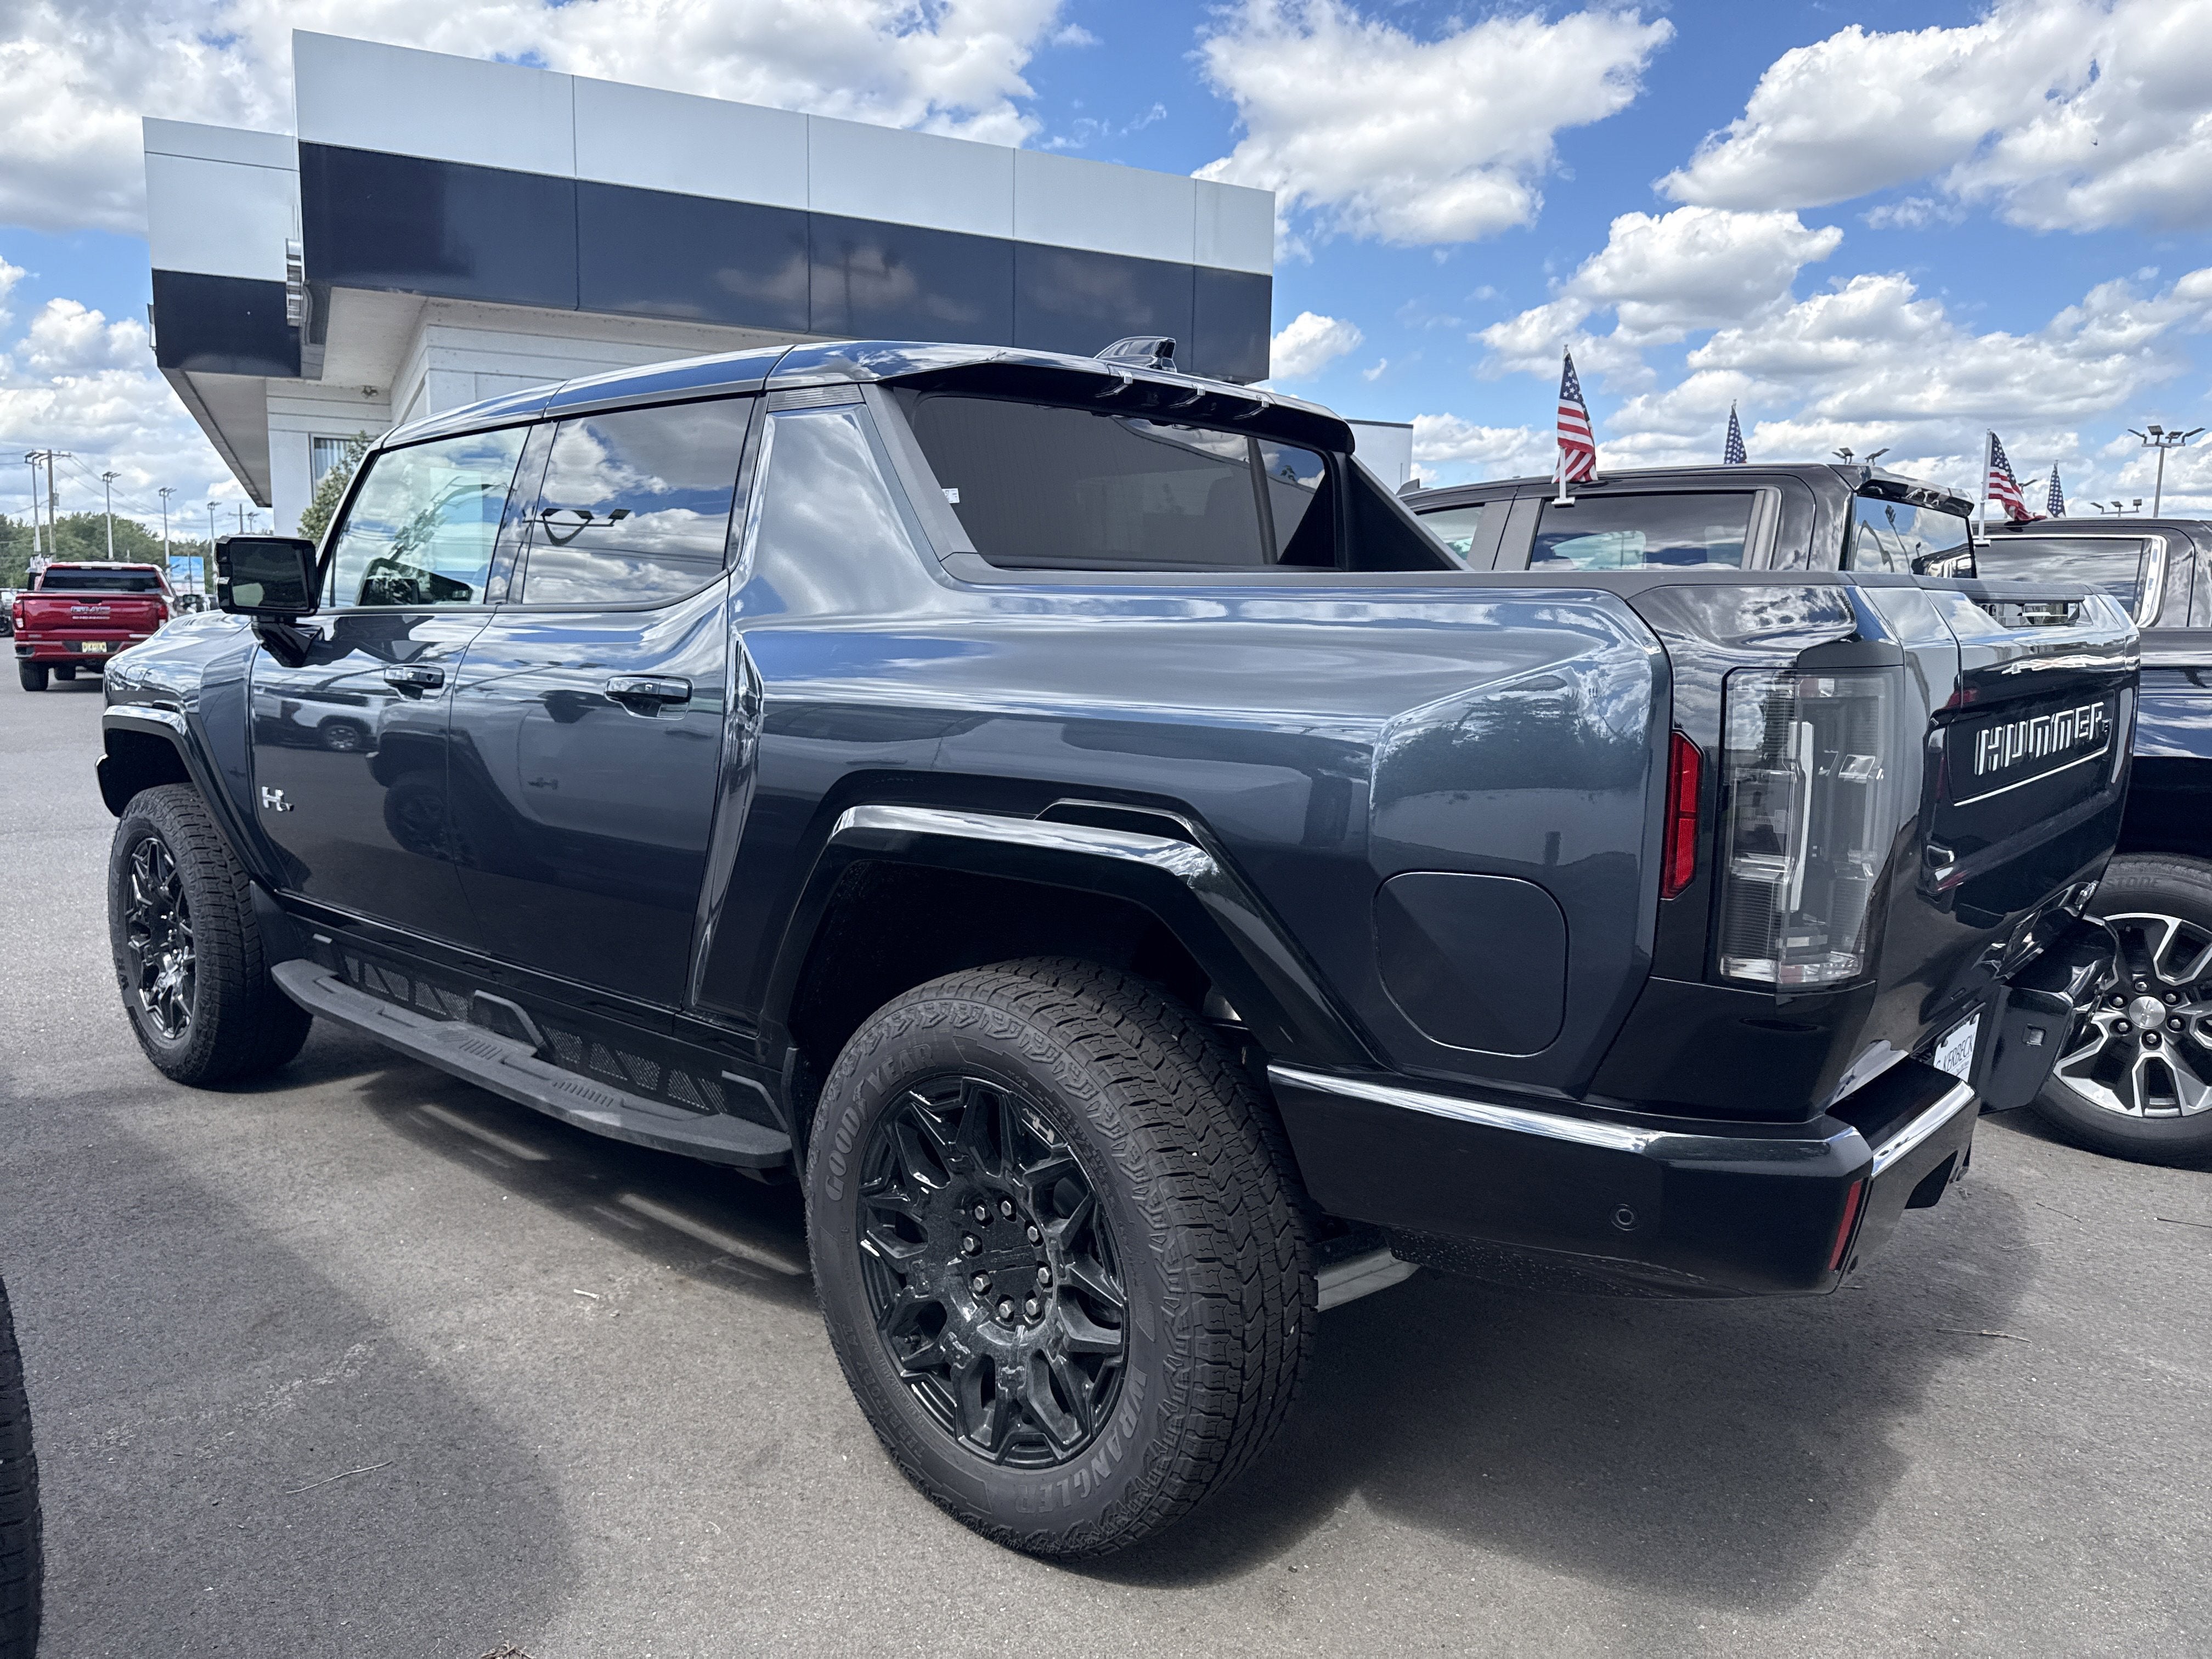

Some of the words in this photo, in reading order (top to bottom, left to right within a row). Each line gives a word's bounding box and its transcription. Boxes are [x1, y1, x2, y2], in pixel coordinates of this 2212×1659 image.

[1975, 702, 2104, 776] HUMMER
[857, 1361, 926, 1459] TERRITORY
[1015, 1363, 1148, 1514] WRANGLER
